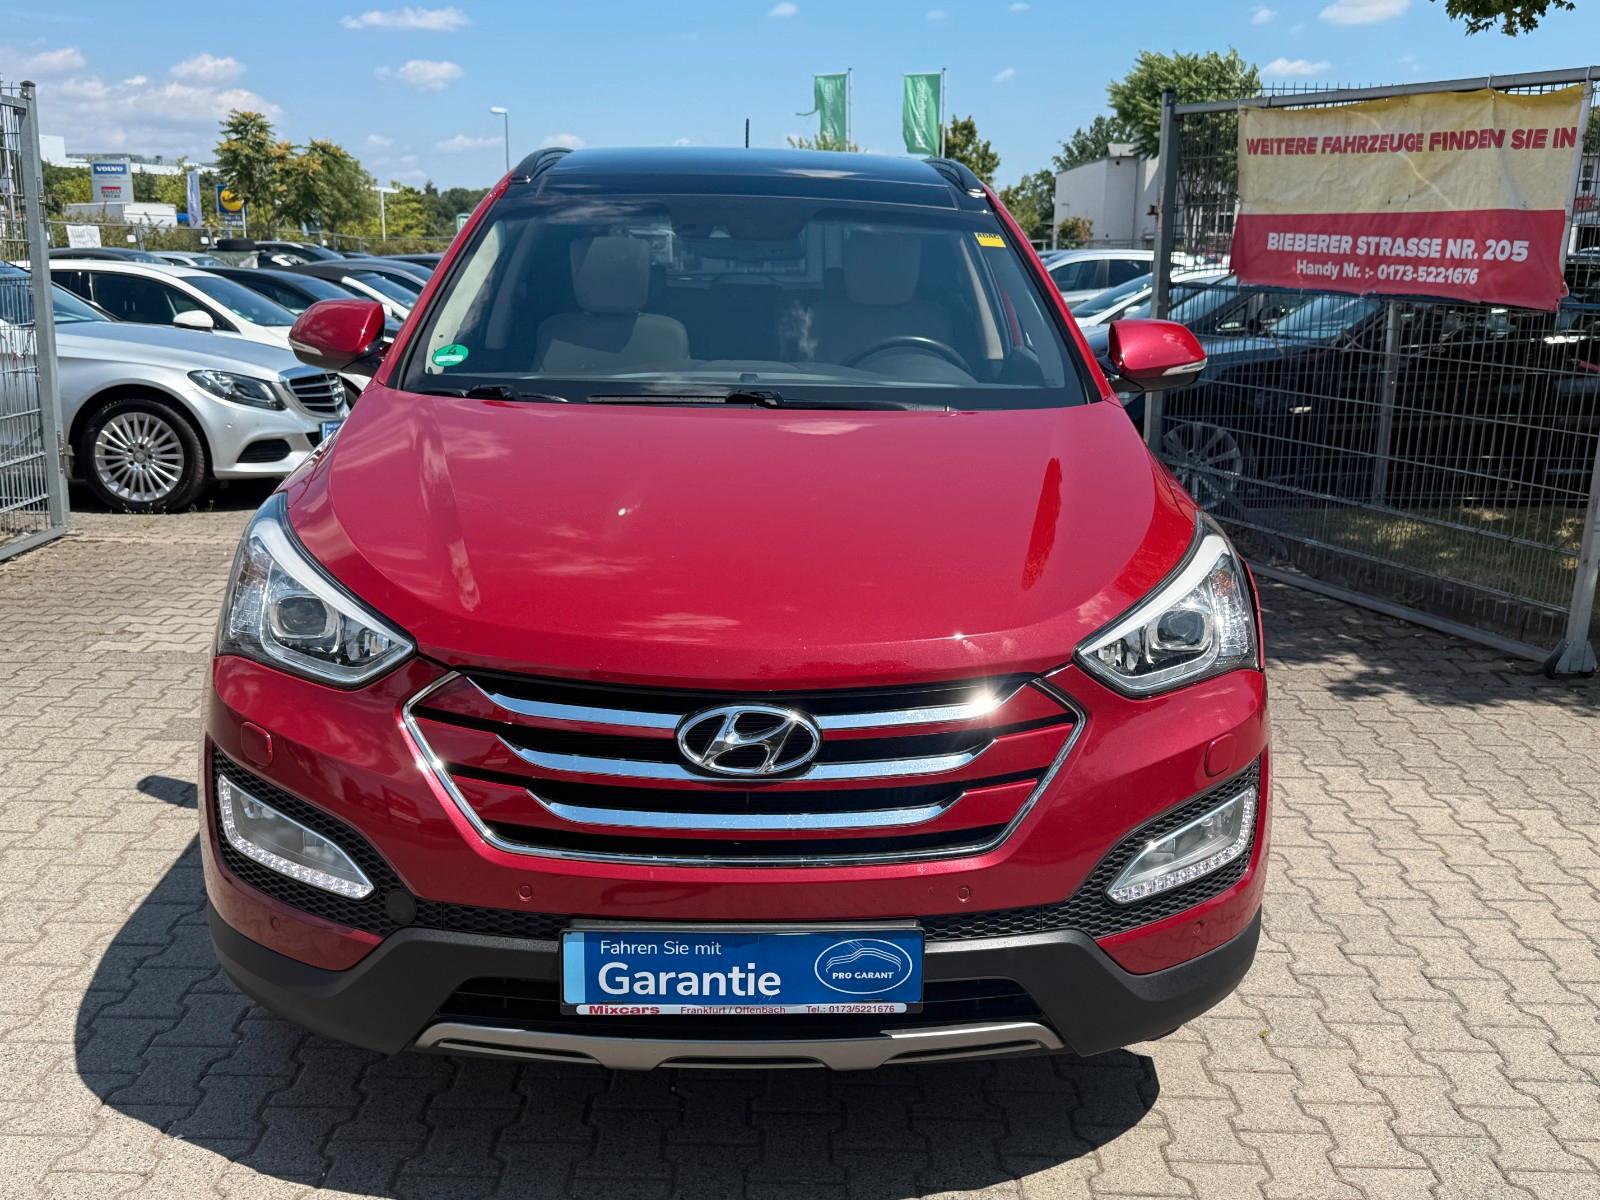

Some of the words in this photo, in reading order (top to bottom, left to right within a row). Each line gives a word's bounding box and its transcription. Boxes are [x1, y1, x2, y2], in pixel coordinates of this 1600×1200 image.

[1246, 136, 1318, 156] WEITERE
[1321, 133, 1425, 154] FAHRZEUGE
[1428, 129, 1506, 152] FINDEN
[1510, 128, 1550, 149] SIE
[1552, 126, 1578, 149] IN
[1267, 232, 1353, 255] BIEBERER
[1356, 235, 1443, 259] STRASSE
[1446, 238, 1479, 260] NR.
[1483, 239, 1530, 263] 205
[1296, 259, 1340, 280] Handy
[1343, 262, 1362, 279] Nr.
[1377, 263, 1479, 286] 0173-5221676
[447, 344, 457, 355] 4
[600, 940, 658, 955] Fahren
[663, 940, 690, 955] Sie
[695, 941, 722, 955] mit
[598, 961, 782, 997] Garantie
[832, 971, 852, 980] PRO
[854, 971, 895, 980] GARANT
[588, 1005, 661, 1014] Mixcars
[680, 1006, 726, 1014] Frankfurt
[734, 1005, 786, 1014] Offenbach
[828, 1005, 895, 1013] 0173/5221676
